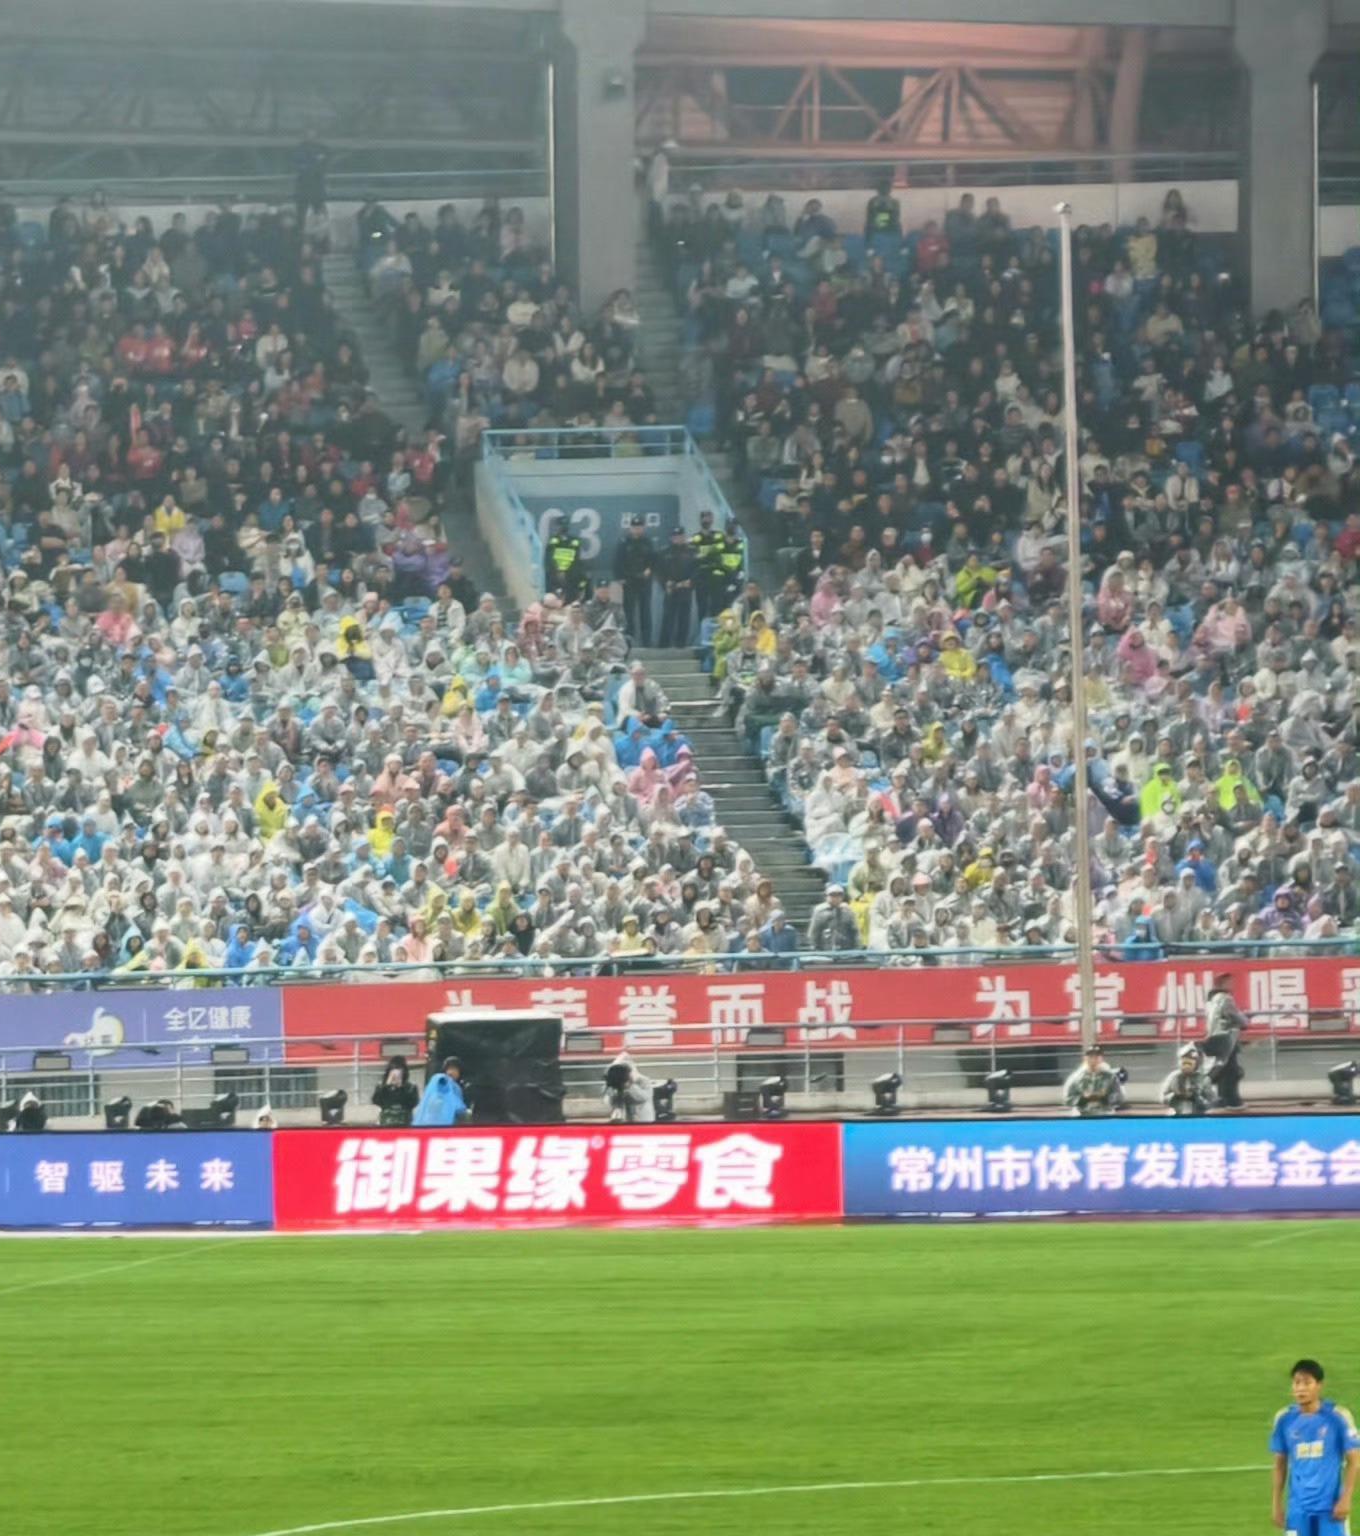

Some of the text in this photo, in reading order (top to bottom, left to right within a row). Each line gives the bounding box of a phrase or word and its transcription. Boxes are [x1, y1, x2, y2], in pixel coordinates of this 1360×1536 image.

[443, 981, 857, 1046] 荣誉而战
[34, 1158, 235, 1194] 智驱未来
[887, 1140, 1360, 1192] 常州市体育发展基金会
